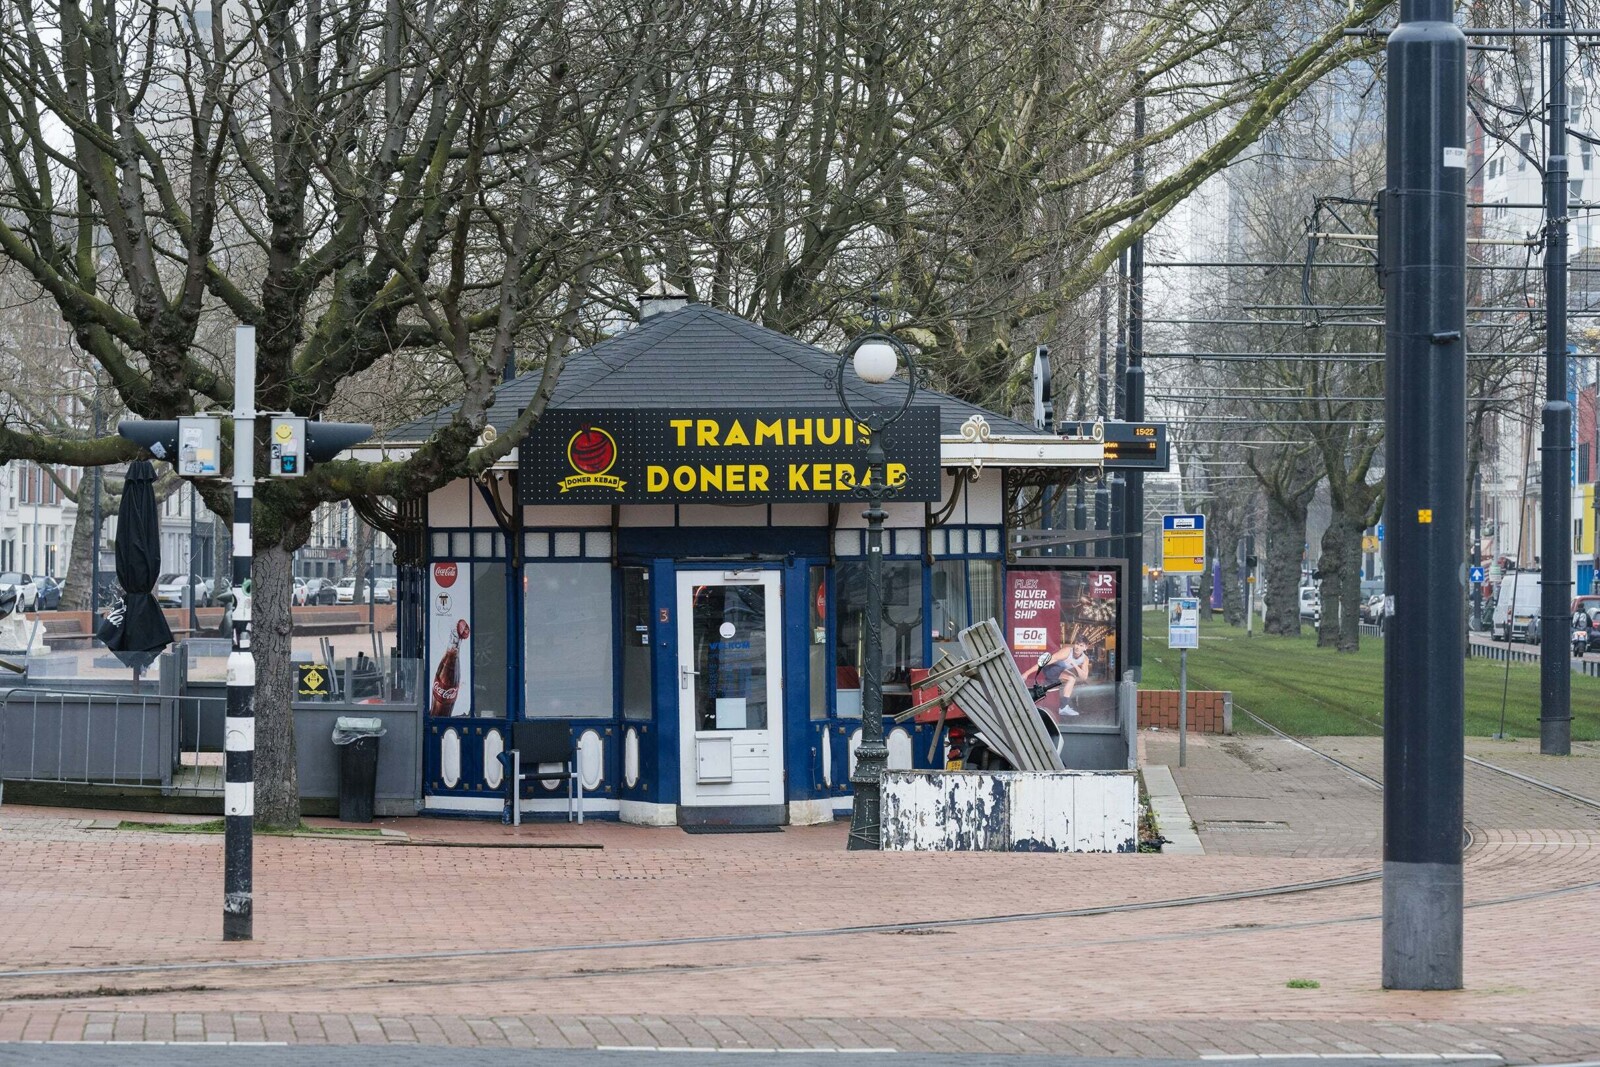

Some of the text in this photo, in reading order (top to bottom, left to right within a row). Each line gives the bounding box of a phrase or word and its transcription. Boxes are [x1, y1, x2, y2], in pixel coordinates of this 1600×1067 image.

[1135, 428, 1154, 436] 15:22
[567, 477, 618, 485] DONER KEBAB
[646, 464, 770, 492] DONER
[434, 566, 457, 577] Coca-Cola
[1014, 578, 1039, 589] FLEX
[1094, 574, 1113, 587] JR
[1014, 589, 1048, 599] SILVER
[1014, 599, 1056, 610] MEMBER
[660, 610, 668, 622] 3
[1014, 610, 1038, 620] SHIP
